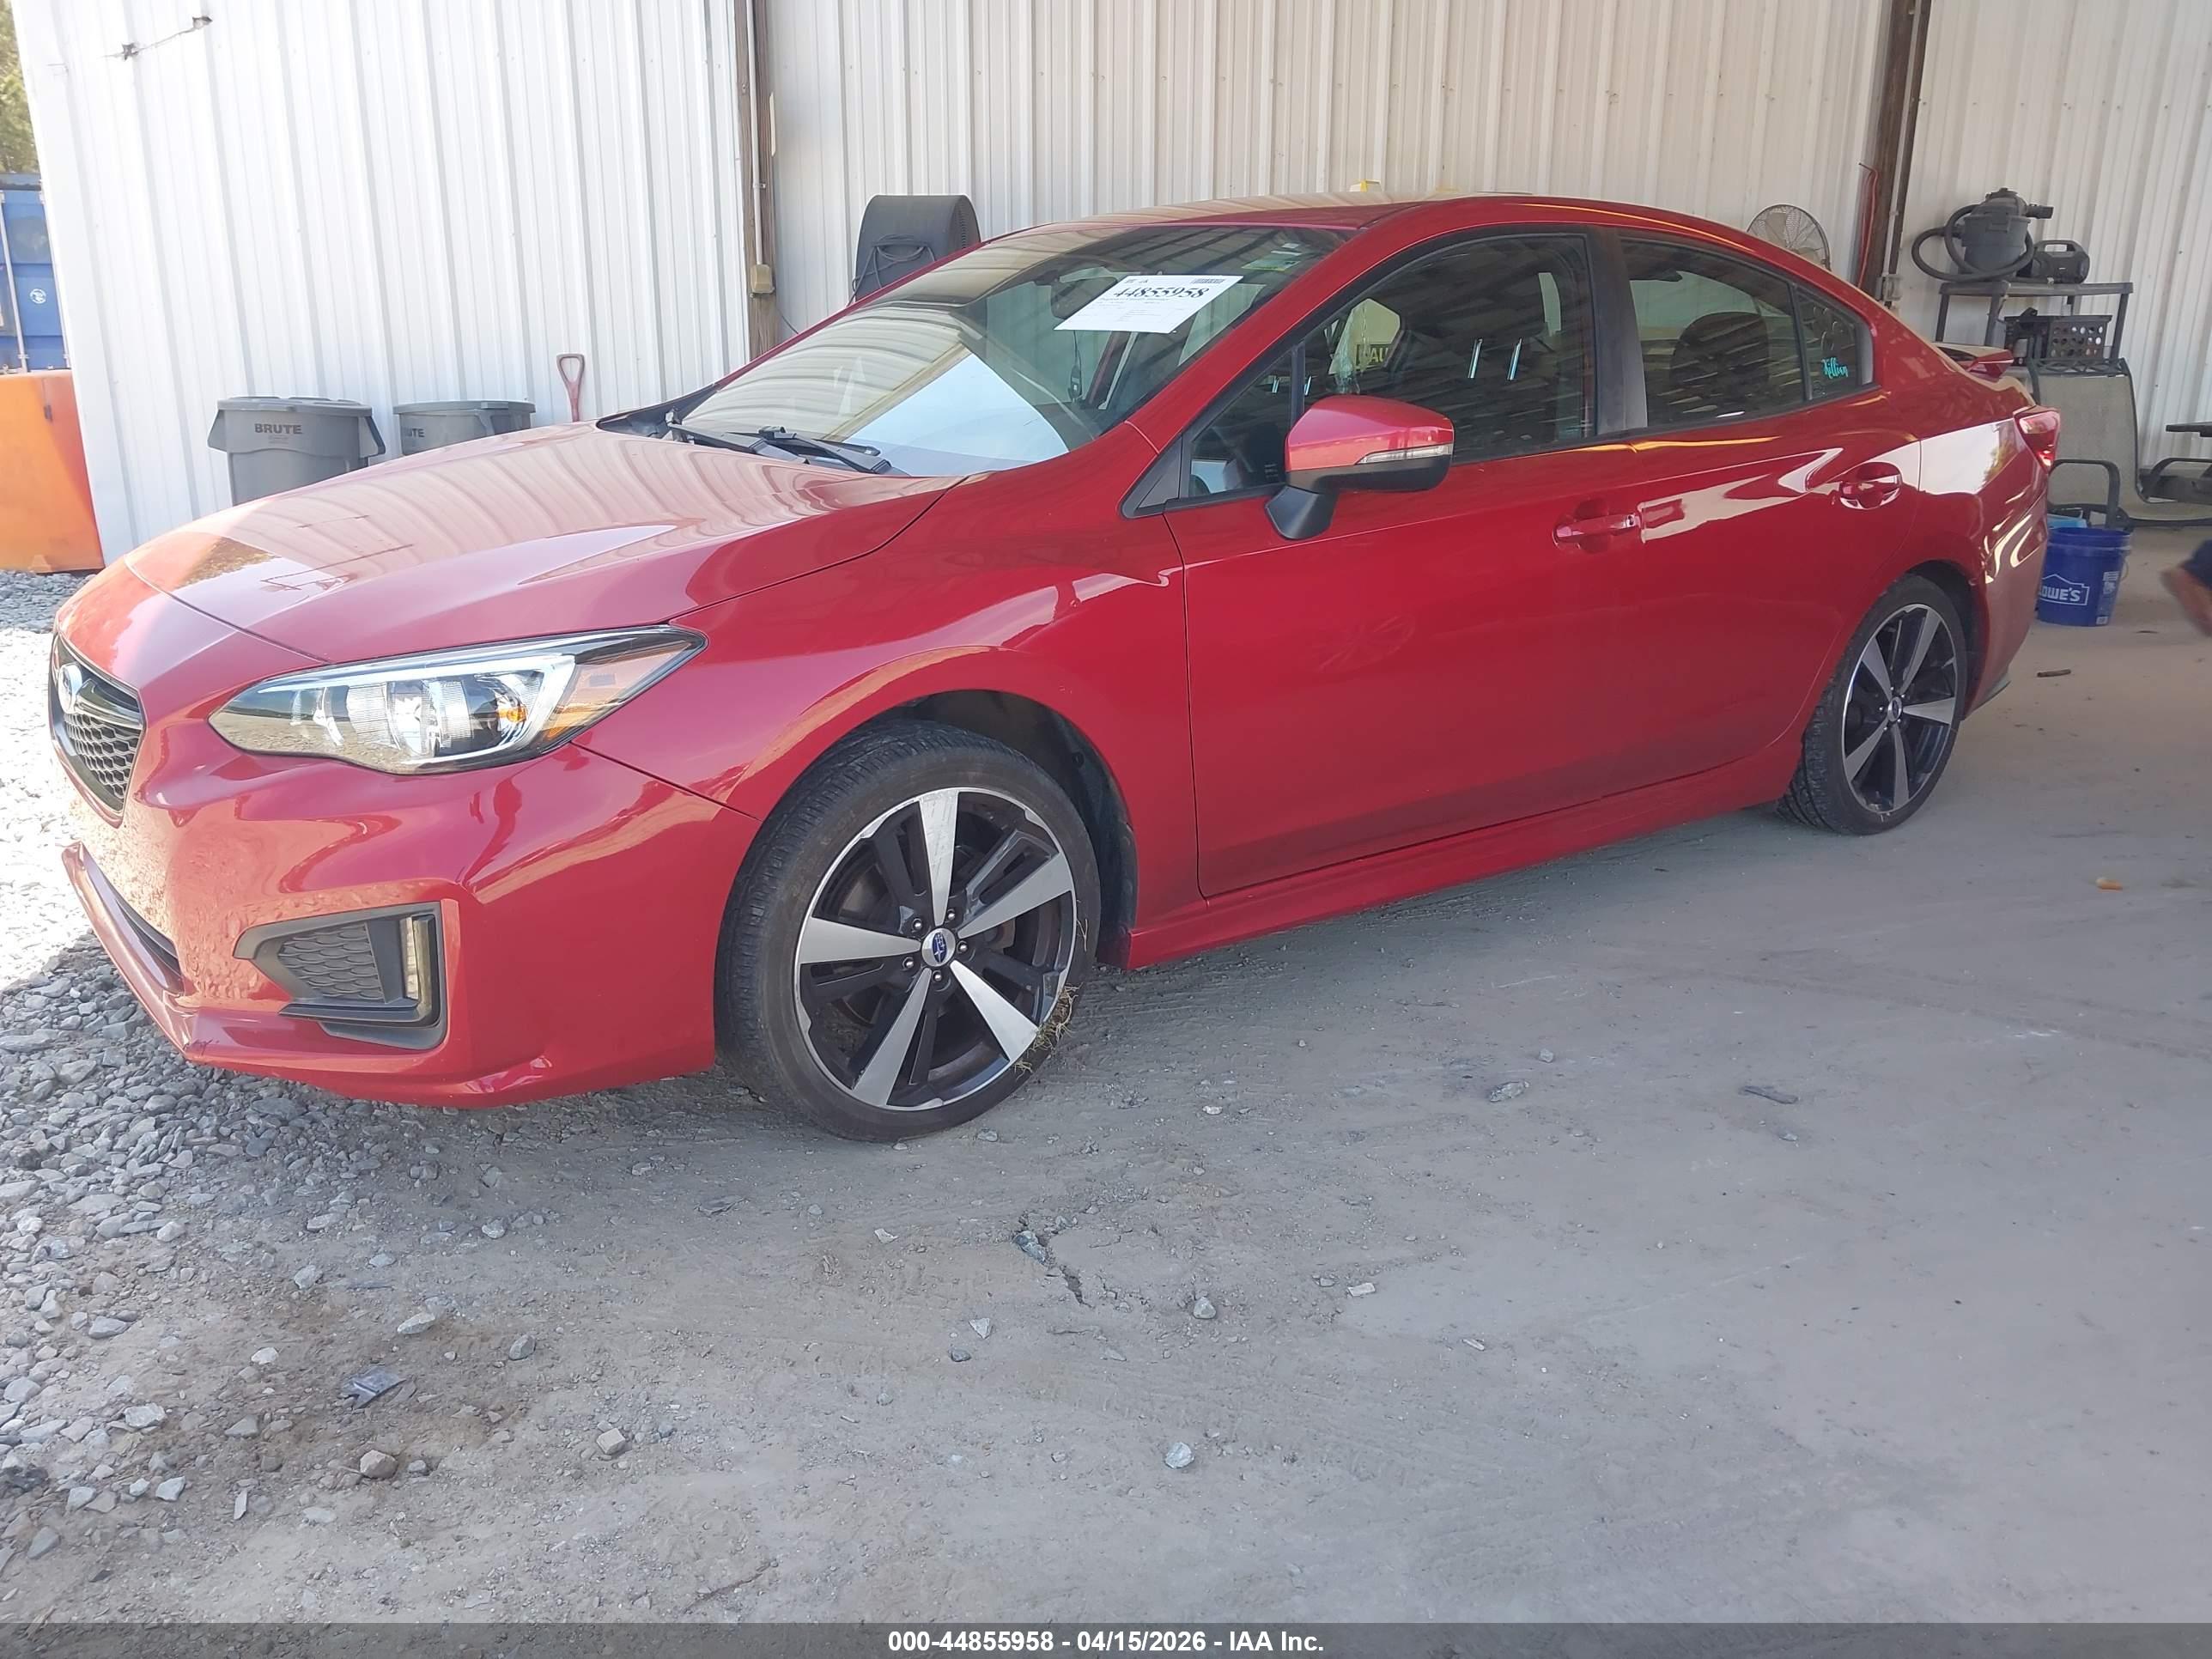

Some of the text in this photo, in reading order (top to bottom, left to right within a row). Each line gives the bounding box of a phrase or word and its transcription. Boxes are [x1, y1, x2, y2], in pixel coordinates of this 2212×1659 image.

[1114, 287, 1209, 298] 44855958
[254, 422, 302, 434] BRUTE
[2040, 585, 2081, 602] OWE'S
